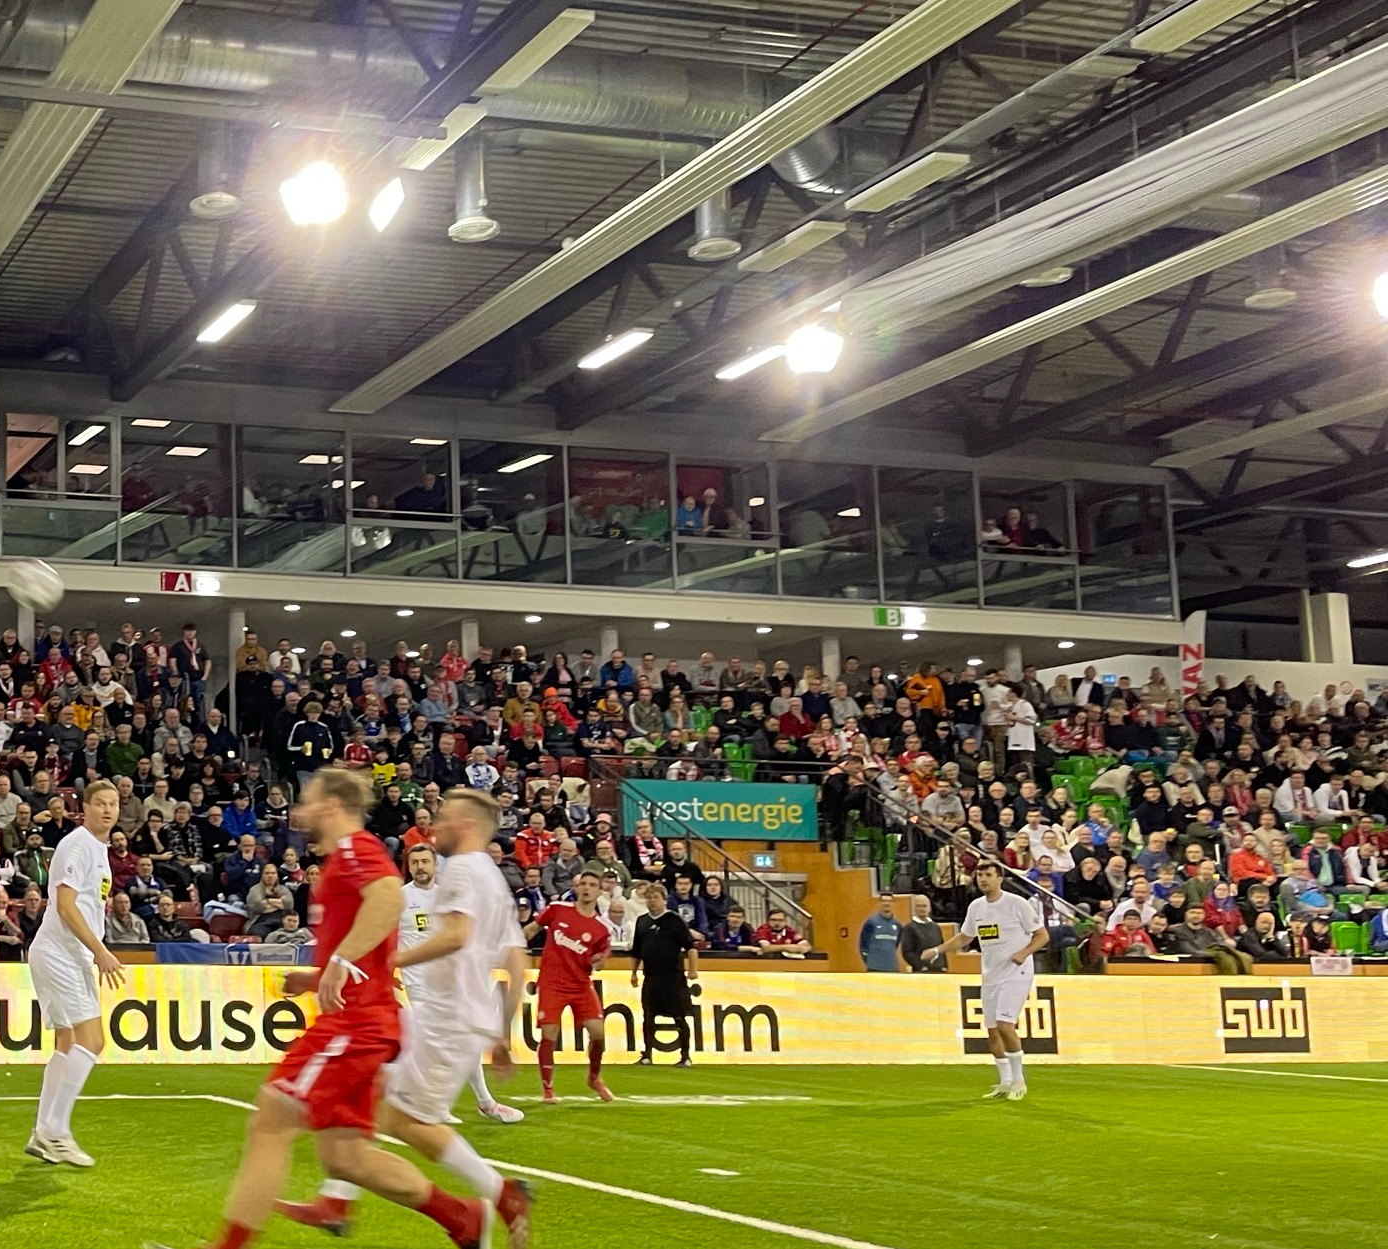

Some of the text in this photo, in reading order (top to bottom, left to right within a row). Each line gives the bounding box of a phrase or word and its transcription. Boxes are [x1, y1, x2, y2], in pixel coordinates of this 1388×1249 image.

[174, 573, 190, 592] A
[887, 608, 900, 626] B
[957, 978, 1053, 1039] sb
[1216, 979, 1306, 1038] swb
